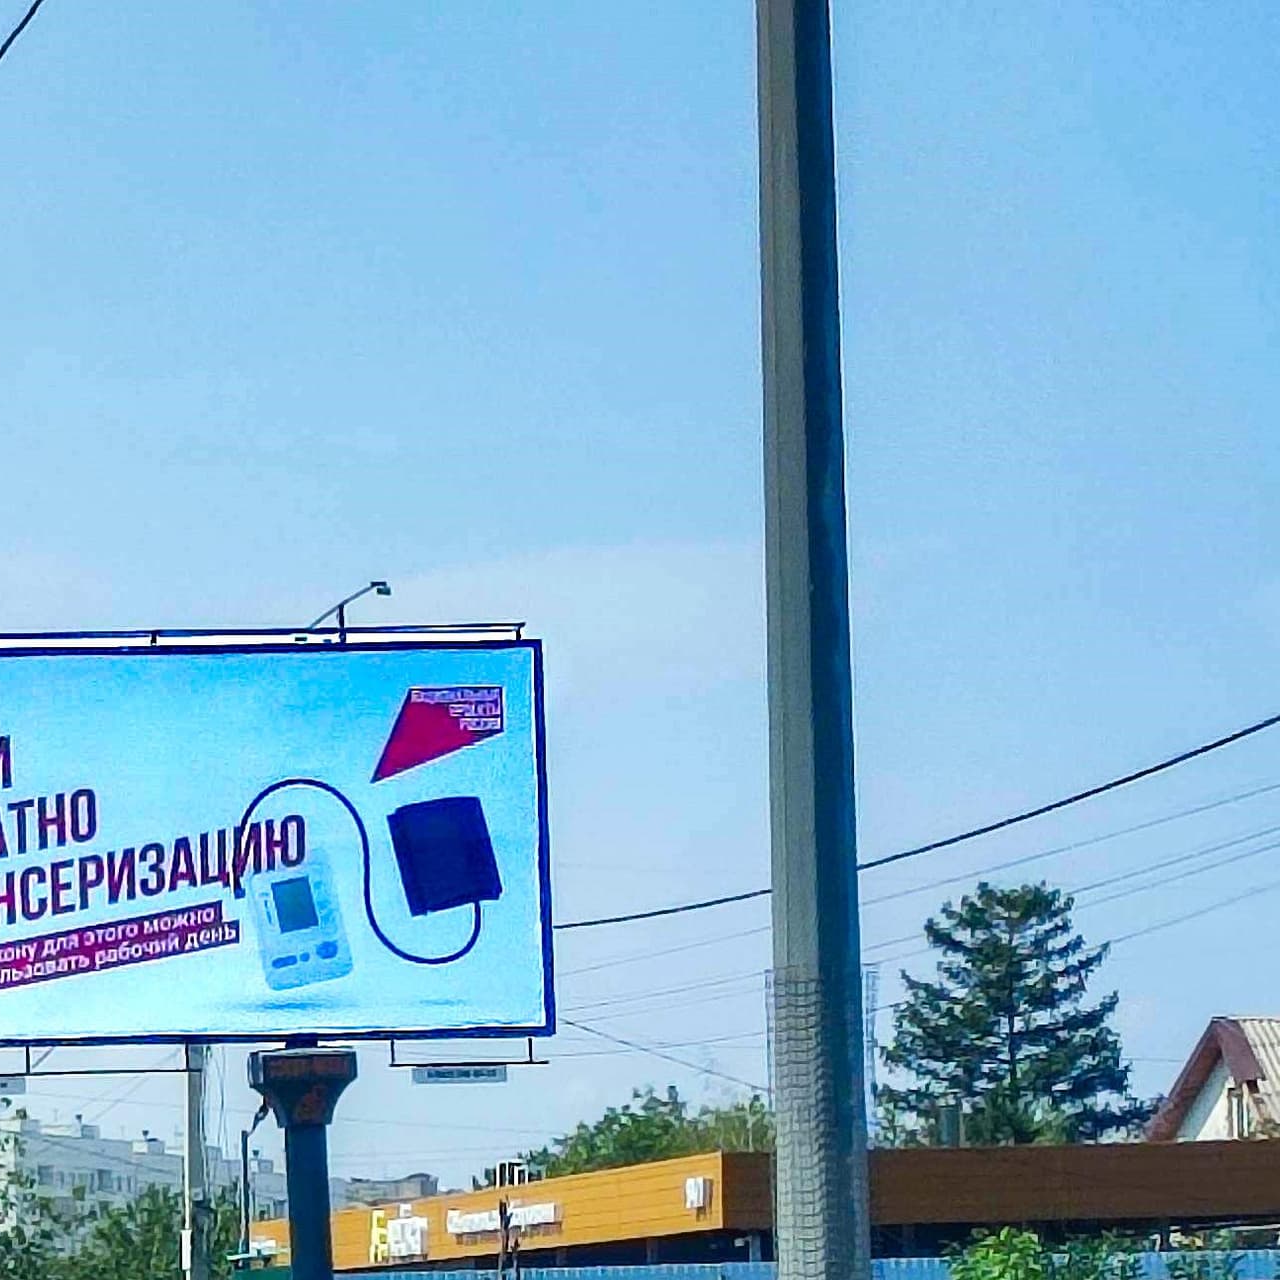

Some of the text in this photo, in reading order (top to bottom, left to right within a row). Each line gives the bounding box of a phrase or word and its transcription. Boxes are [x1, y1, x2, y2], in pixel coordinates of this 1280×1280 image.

[42, 933, 80, 958] для
[83, 924, 138, 947] этого
[143, 907, 216, 936] можно
[95, 931, 180, 970] рабочий
[185, 923, 237, 951] день
